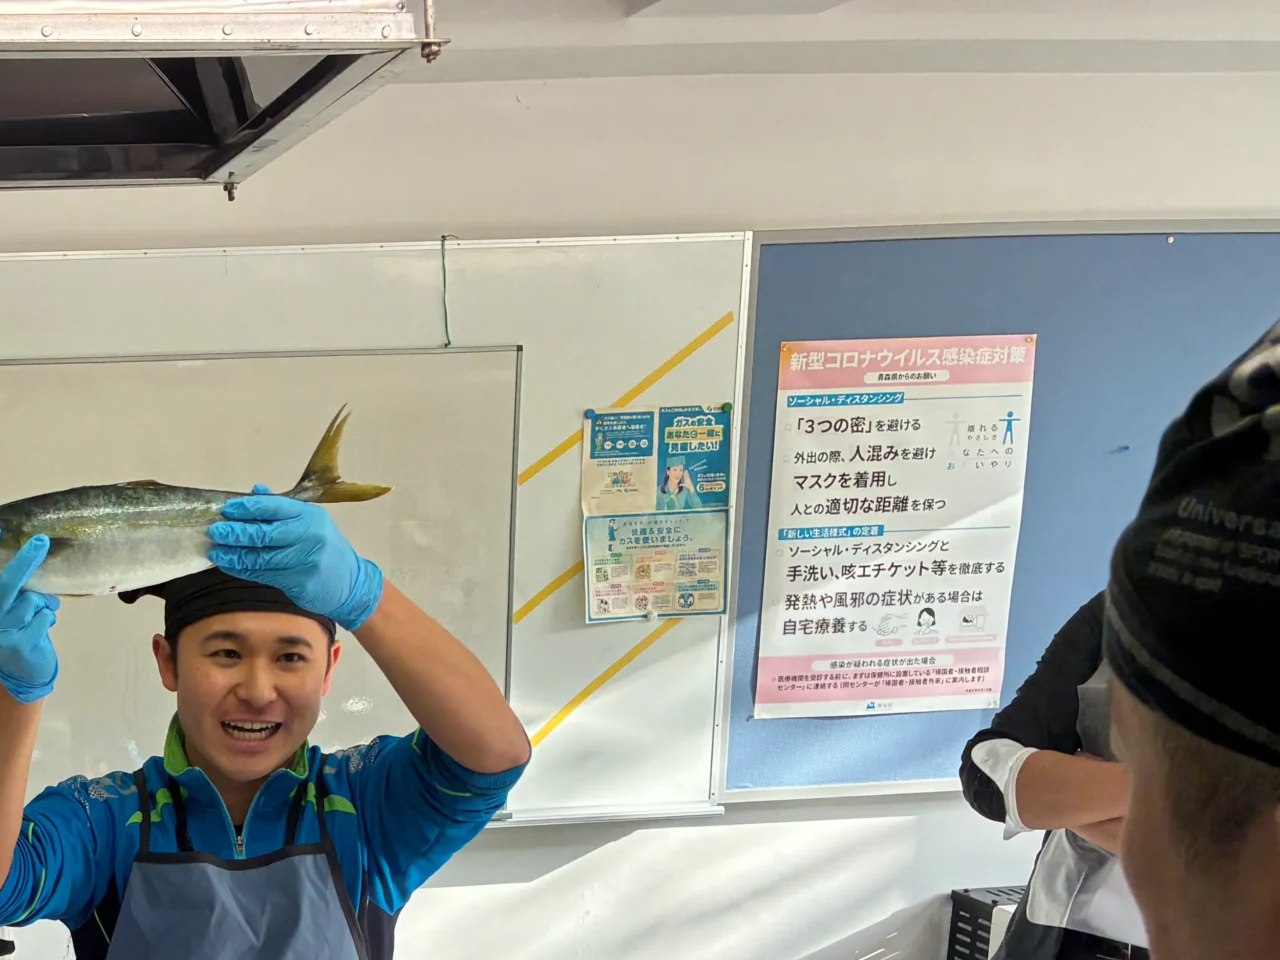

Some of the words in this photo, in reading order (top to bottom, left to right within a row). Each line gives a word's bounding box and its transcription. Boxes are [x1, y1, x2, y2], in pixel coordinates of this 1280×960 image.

[789, 345, 1027, 372] 新型コロナウイルス感染症対策
[877, 372, 937, 382] 青森県からのお願い
[789, 392, 904, 406] ソーシャル・ディスタンシング
[793, 445, 937, 465] 外出の際、人混みを避け
[948, 447, 1014, 459] なたへの
[946, 459, 1013, 471] おいやり
[793, 471, 898, 491] マスクを着用し
[790, 495, 947, 516] 人との適切な距離を保つ
[789, 540, 950, 558] ソーシャル・ディスタンシングと
[786, 559, 1006, 583] 手洗い、咳エチケット等を徹底する
[785, 589, 984, 611] 発熱や風邪の症状がある場合は
[782, 617, 869, 637] 自宅療養する
[829, 657, 937, 669] 感染が疑われる症状が出た場合
